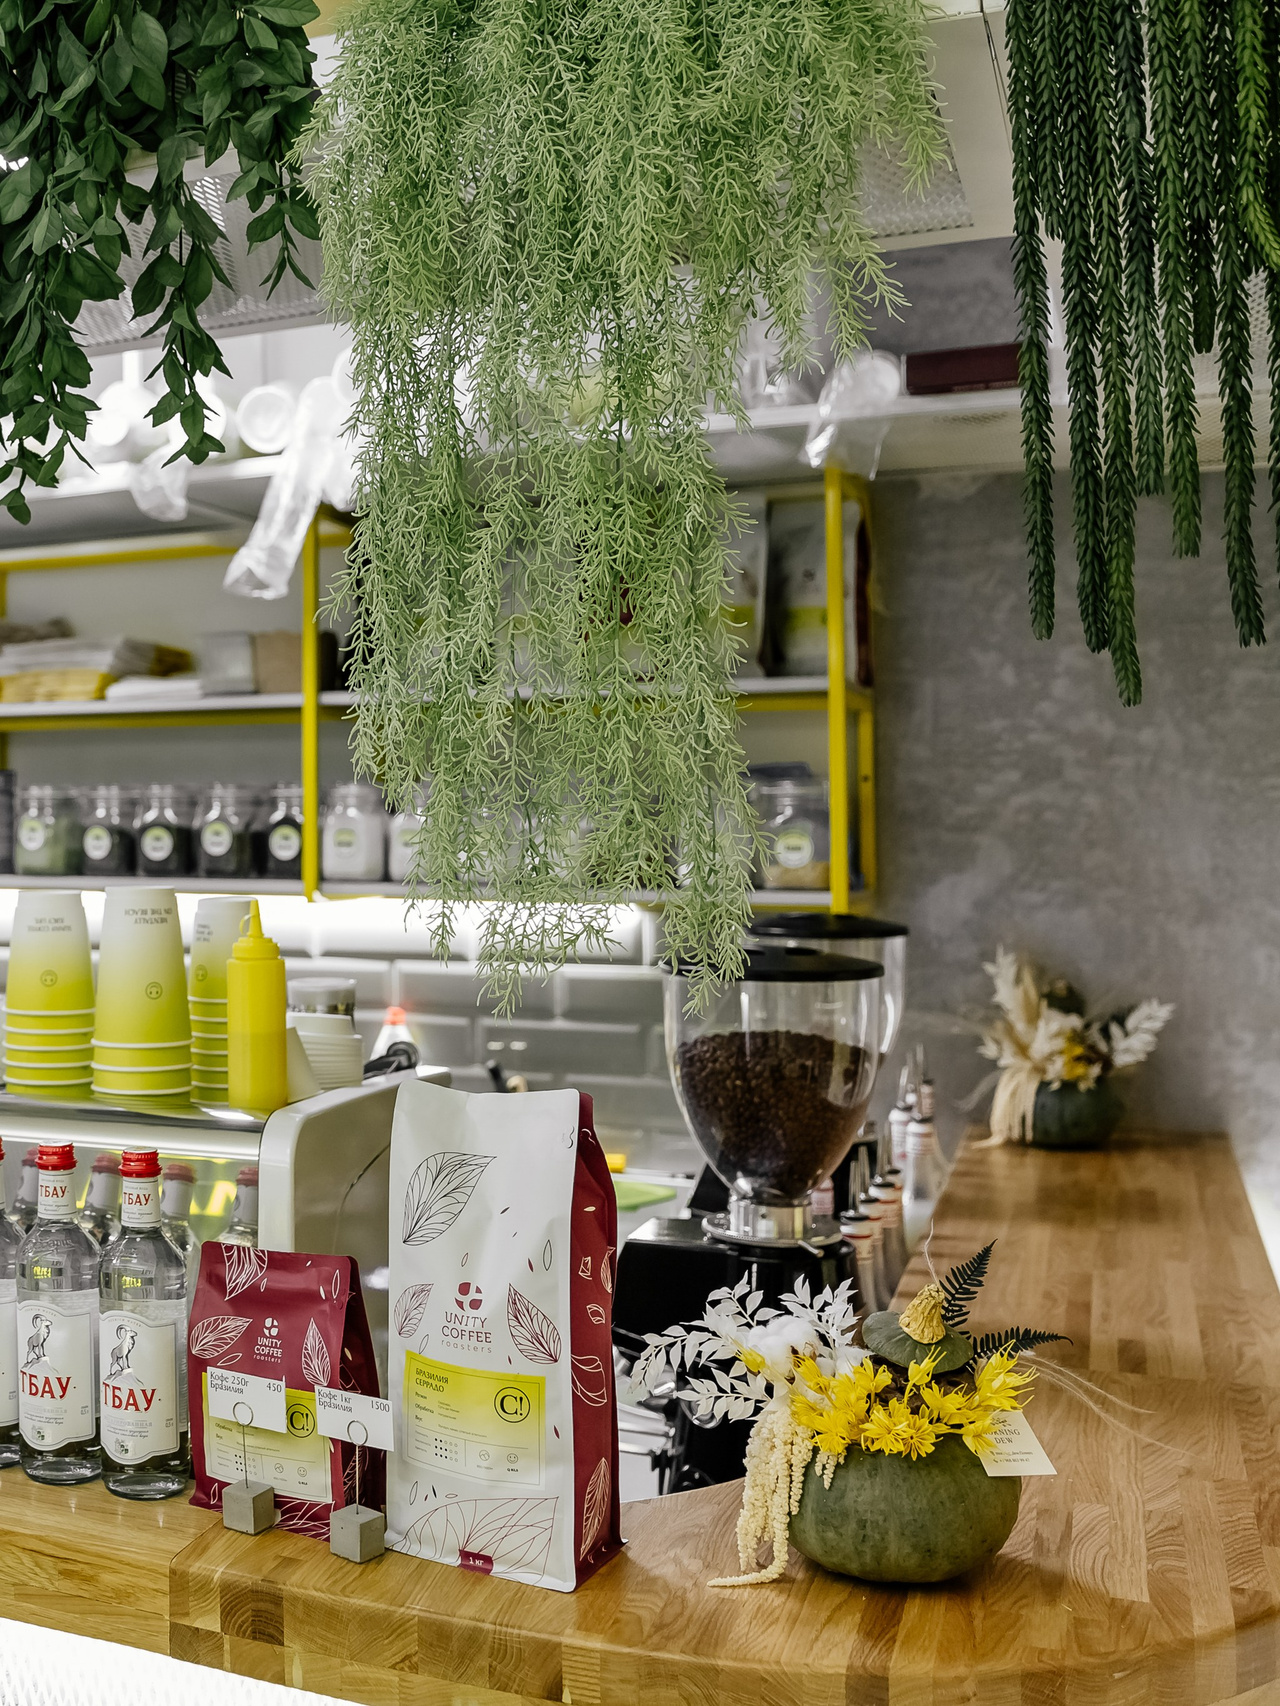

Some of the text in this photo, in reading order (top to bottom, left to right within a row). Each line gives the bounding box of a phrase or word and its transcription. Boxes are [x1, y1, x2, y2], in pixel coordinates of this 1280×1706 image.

[124, 907, 147, 916] BEACH
[148, 907, 161, 916] THE
[134, 916, 168, 925] MENTALLY
[39, 1184, 68, 1198] ТБАУ
[122, 1192, 152, 1206] ТБАУ
[445, 1311, 487, 1328] UNITY
[441, 1325, 492, 1343] COFFEE
[257, 1336, 282, 1348] UNITY
[441, 1340, 492, 1353] roasters
[253, 1354, 281, 1363] roasters
[254, 1345, 283, 1358] COFFEE
[210, 1371, 282, 1393] Кофе 250г 450
[415, 1367, 449, 1385] БРАЗИЛИЯ
[20, 1369, 72, 1400] ТБАУ
[210, 1380, 244, 1395] Бразилия
[415, 1377, 445, 1393] СЕРРАДО
[102, 1381, 157, 1412] ТБАУ
[318, 1388, 338, 1402] Кофе
[371, 1400, 390, 1413] 1500
[318, 1398, 353, 1413] Бразилия
[469, 1556, 474, 1565] 1
